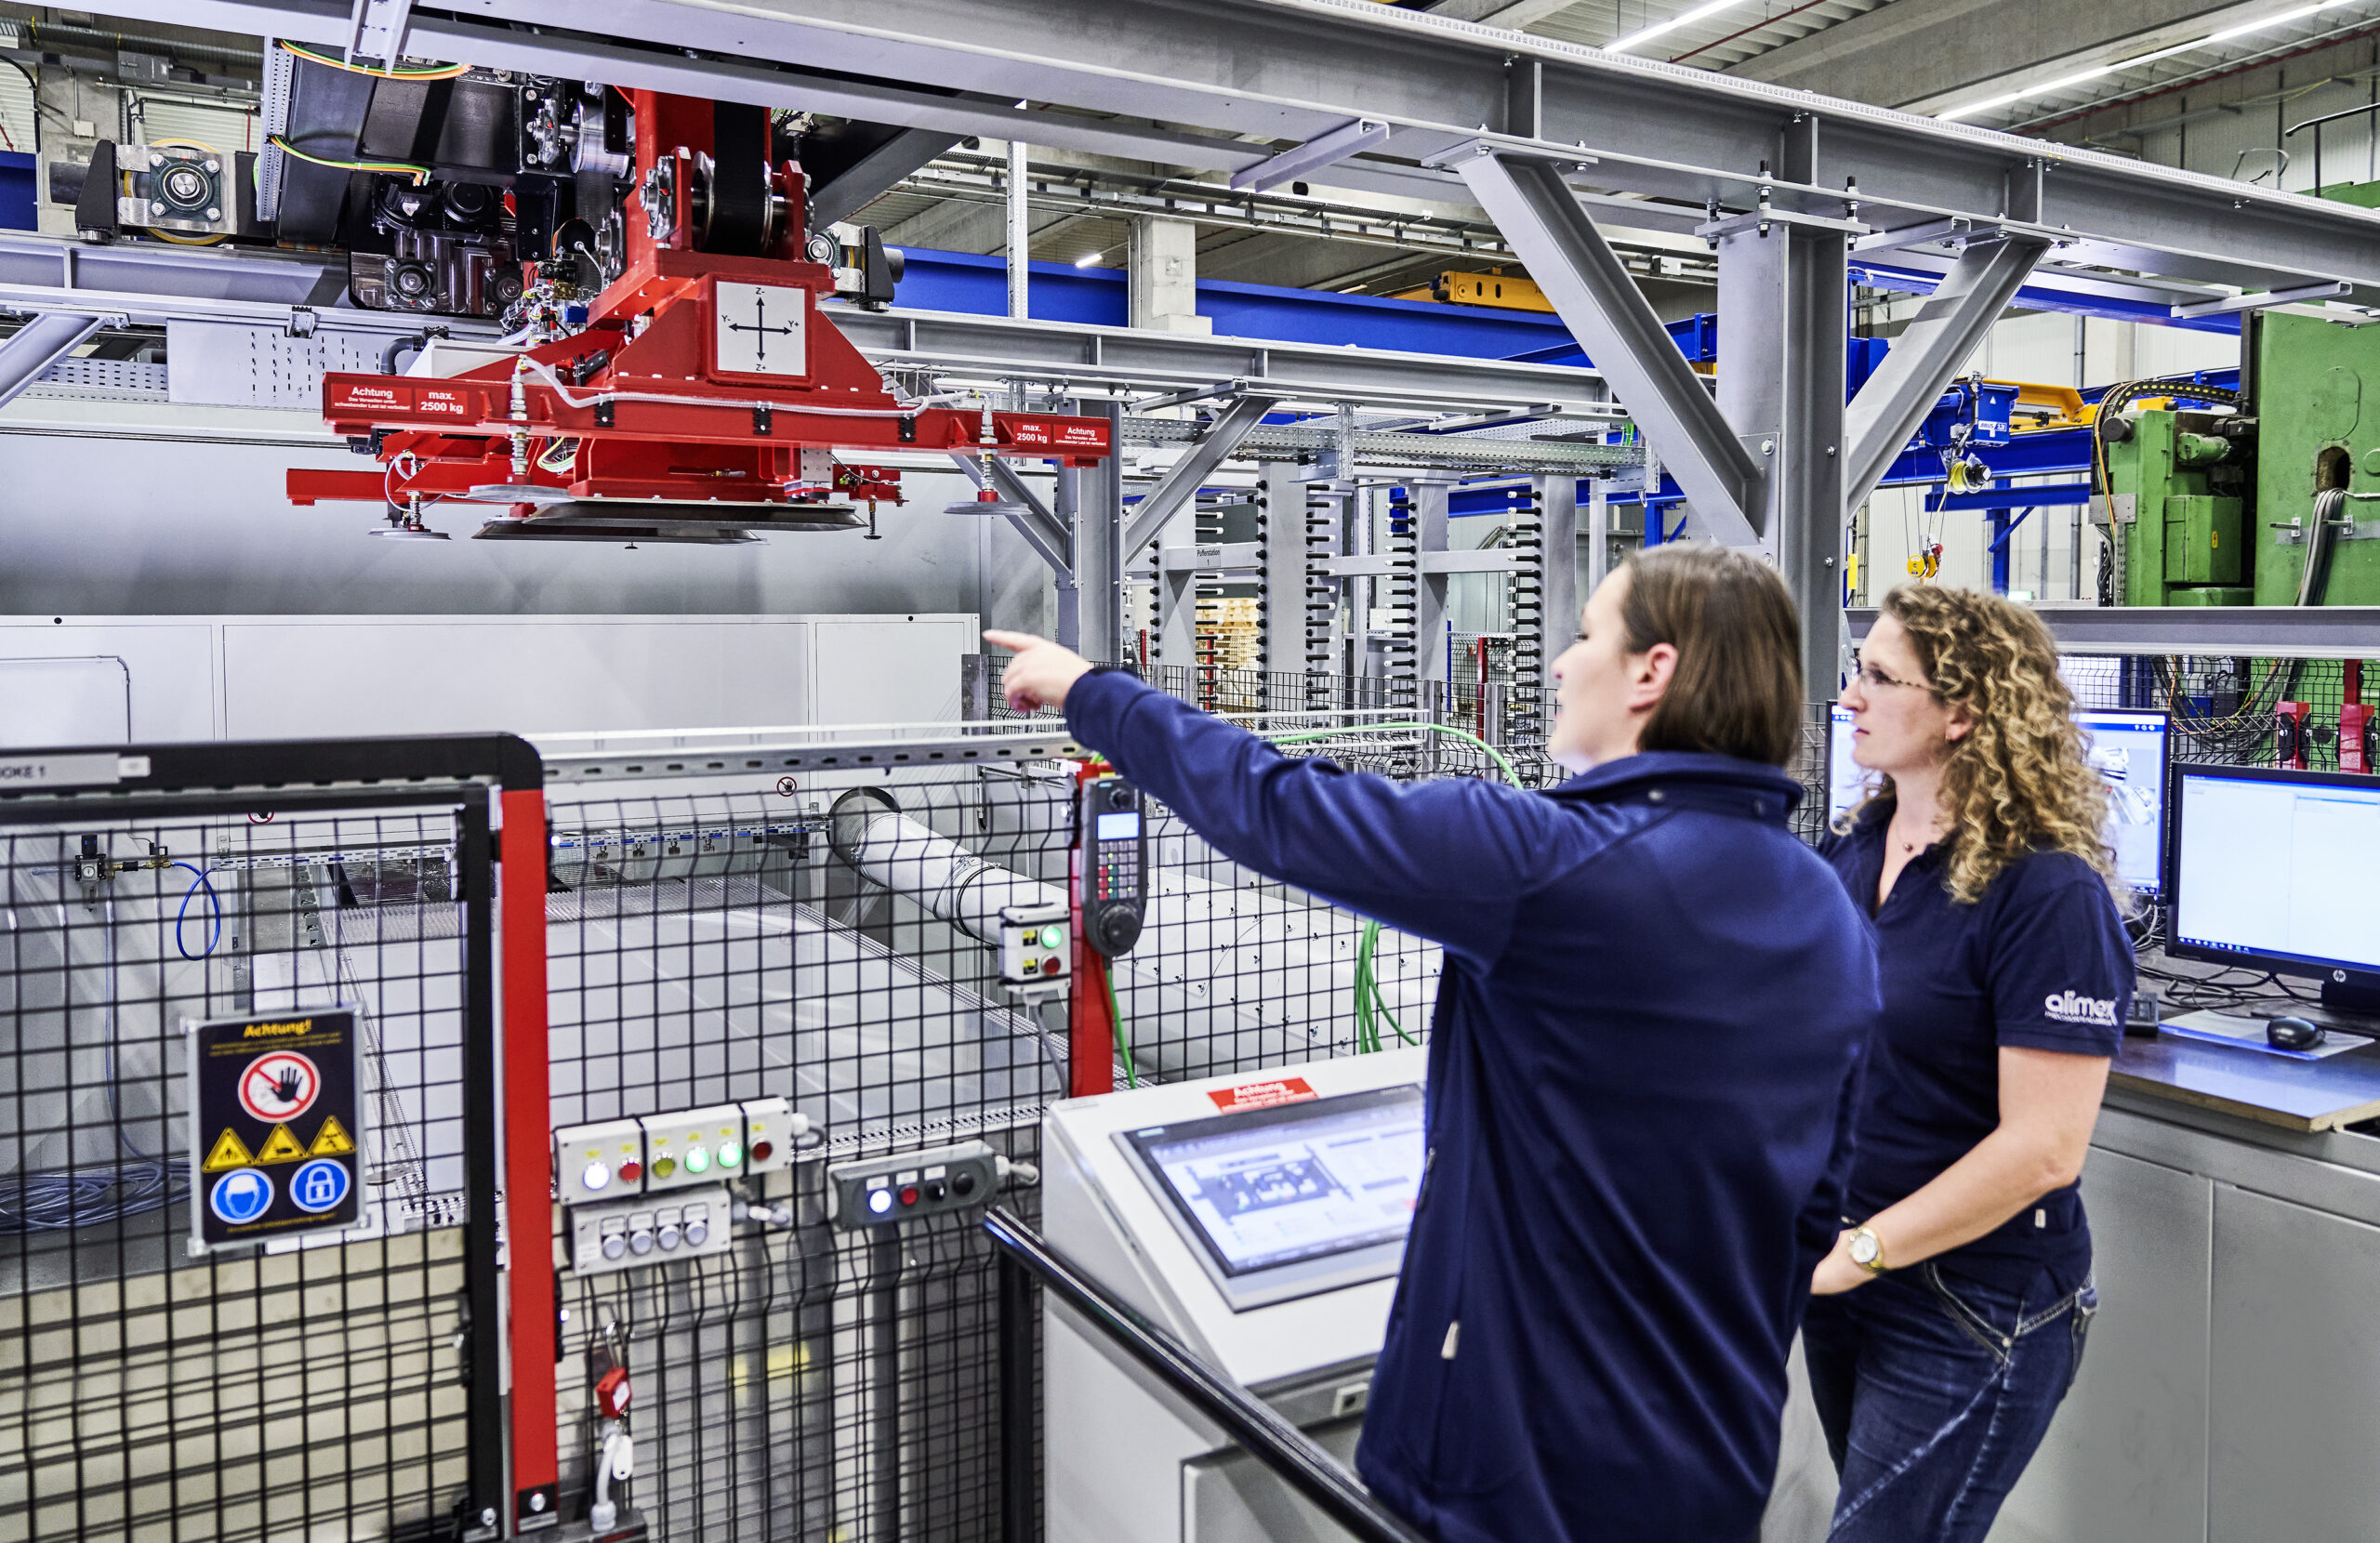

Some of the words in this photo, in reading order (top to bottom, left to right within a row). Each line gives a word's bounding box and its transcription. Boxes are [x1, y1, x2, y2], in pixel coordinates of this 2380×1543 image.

[788, 320, 800, 328] Y+
[351, 387, 393, 400] Achtung
[429, 391, 456, 401] max.
[420, 402, 447, 412] 2500
[449, 402, 464, 415] kg
[1022, 424, 1042, 432] max.
[1067, 427, 1095, 438] Achtung
[1017, 432, 1037, 442] 2500
[1038, 434, 1048, 444] kg
[2044, 989, 2119, 1027] alimex
[244, 1019, 312, 1038] Achtung!
